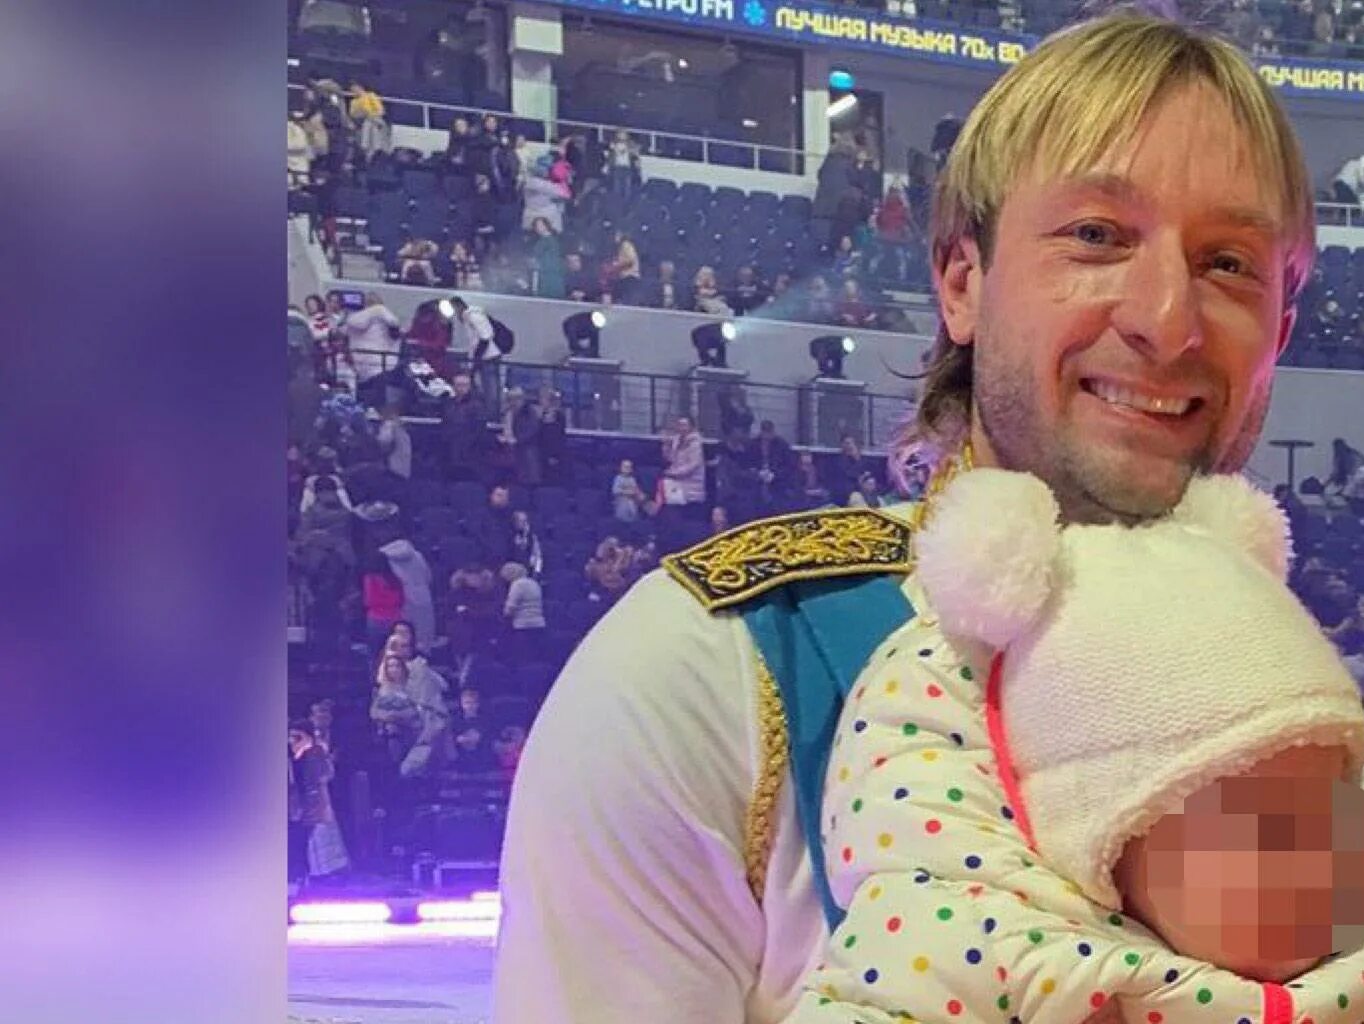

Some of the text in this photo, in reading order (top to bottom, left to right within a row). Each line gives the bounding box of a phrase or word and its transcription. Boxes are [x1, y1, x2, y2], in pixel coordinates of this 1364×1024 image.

[776, 6, 866, 40] ЛУЧШАЯ
[871, 22, 956, 54] МУЗЫКА
[999, 41, 1028, 63] 80
